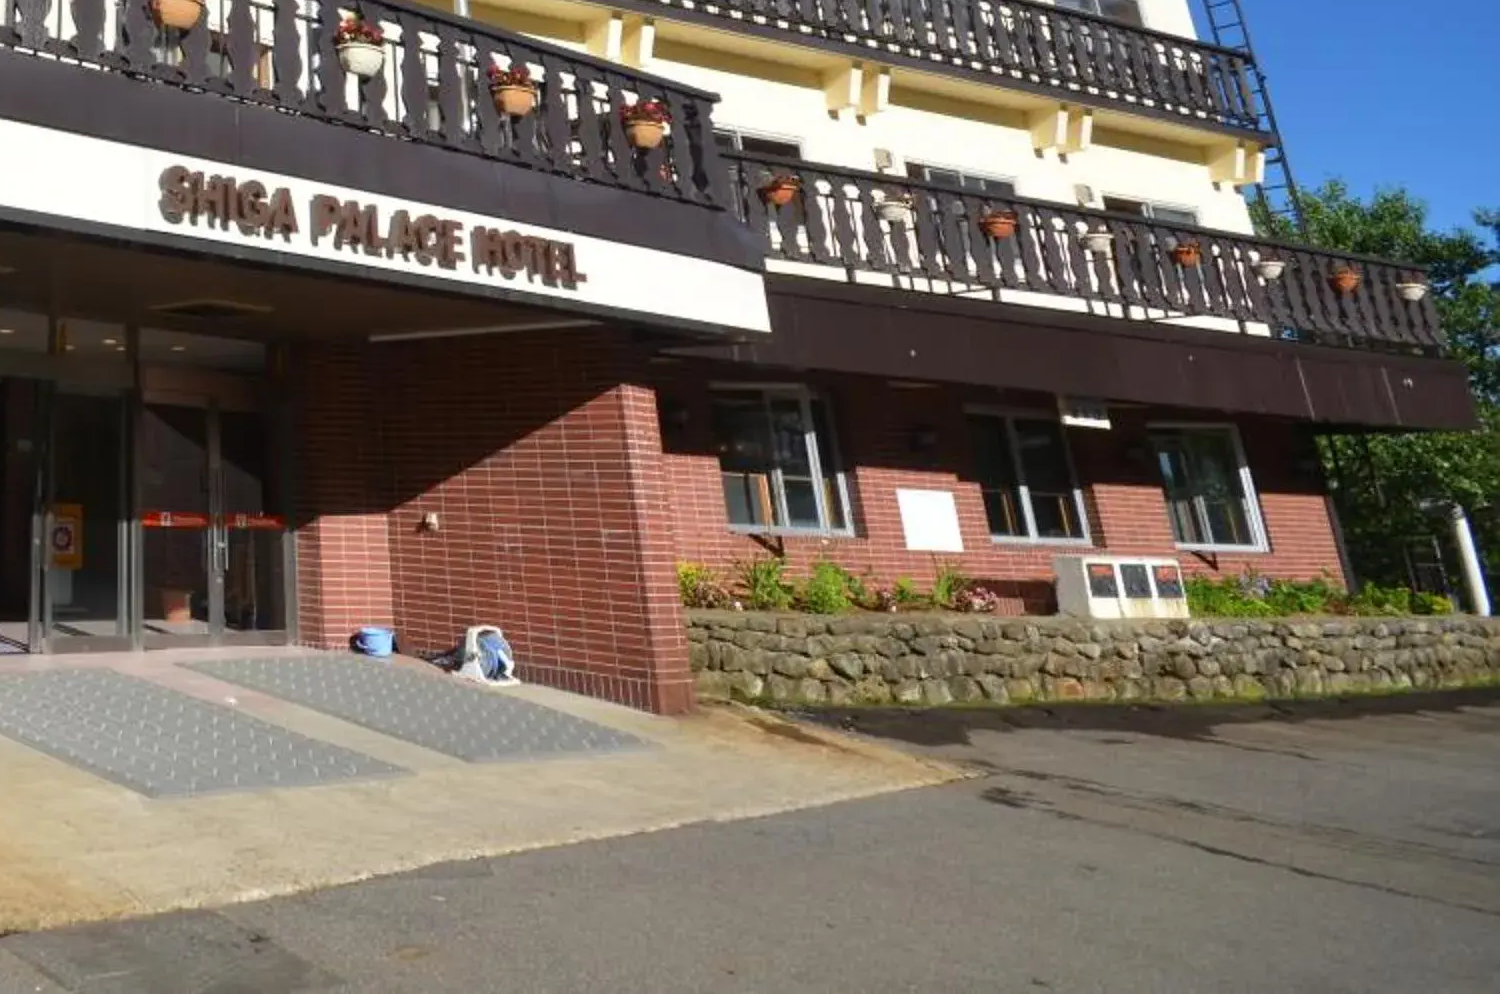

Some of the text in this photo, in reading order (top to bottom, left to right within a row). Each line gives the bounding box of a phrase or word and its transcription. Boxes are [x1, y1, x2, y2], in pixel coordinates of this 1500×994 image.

[158, 165, 587, 290] SHIGA PALACE HOTEL
